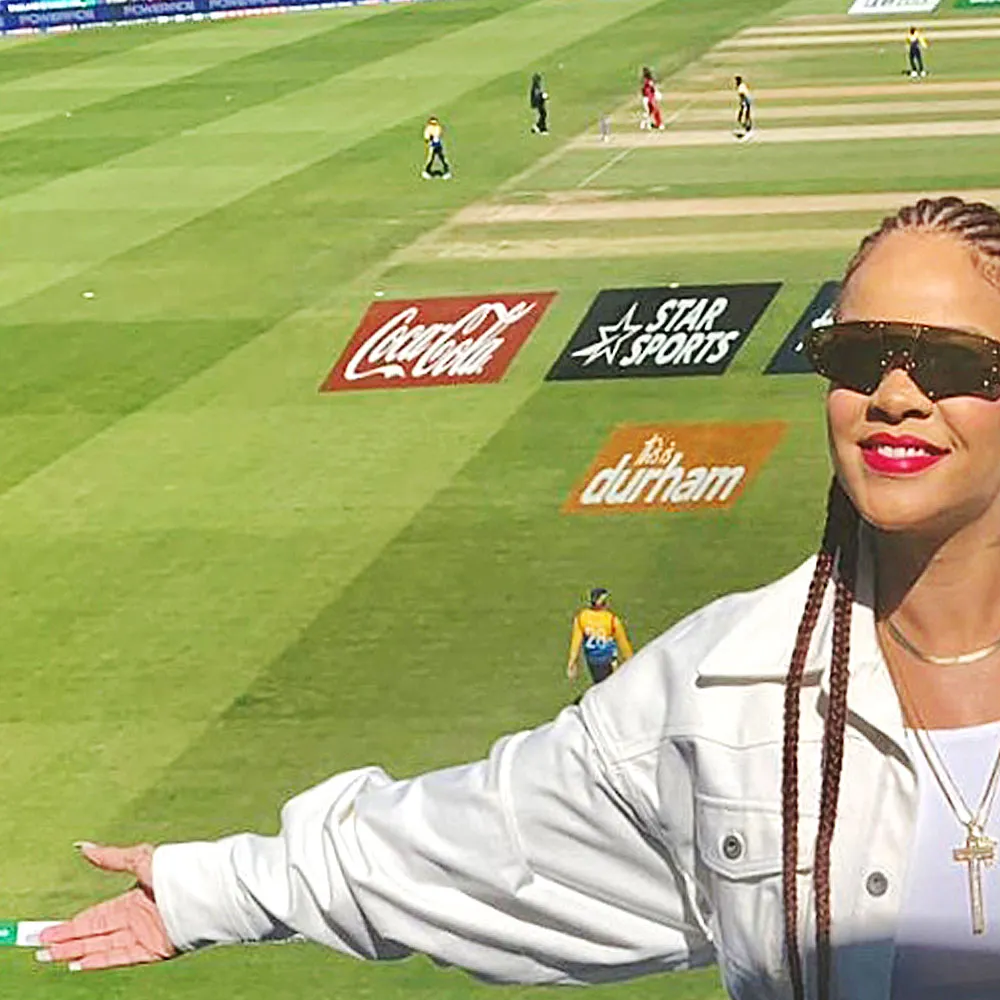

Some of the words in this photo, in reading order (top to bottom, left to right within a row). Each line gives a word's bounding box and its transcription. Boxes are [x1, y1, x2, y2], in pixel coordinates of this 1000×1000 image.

[645, 297, 728, 332] STAR
[619, 330, 740, 367] SPORTS
[580, 451, 746, 505] durham
